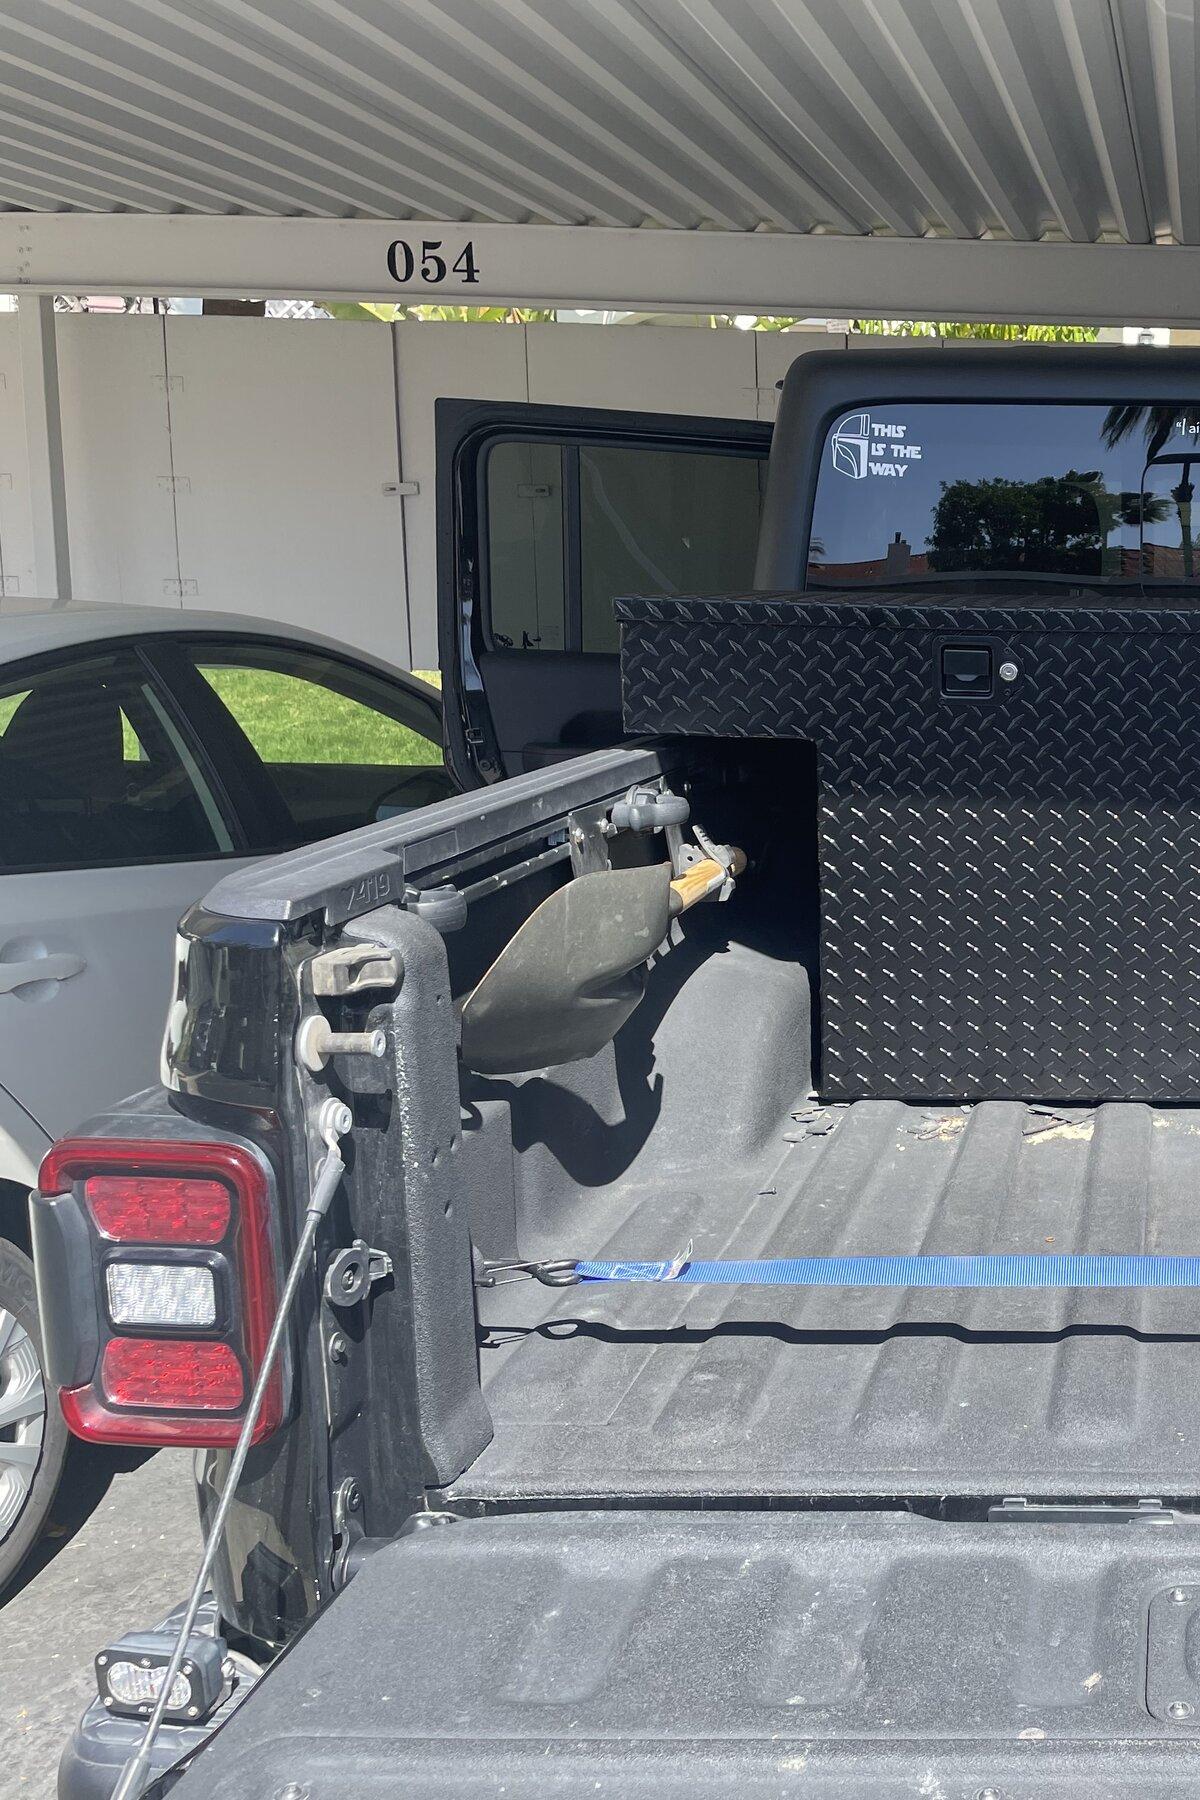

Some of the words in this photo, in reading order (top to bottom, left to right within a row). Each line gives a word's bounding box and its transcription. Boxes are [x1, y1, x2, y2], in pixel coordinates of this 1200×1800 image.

[387, 240, 480, 283] 054
[871, 423, 907, 438] THIS
[871, 442, 887, 456] IS
[890, 444, 922, 459] THE
[868, 462, 908, 477] WAY
